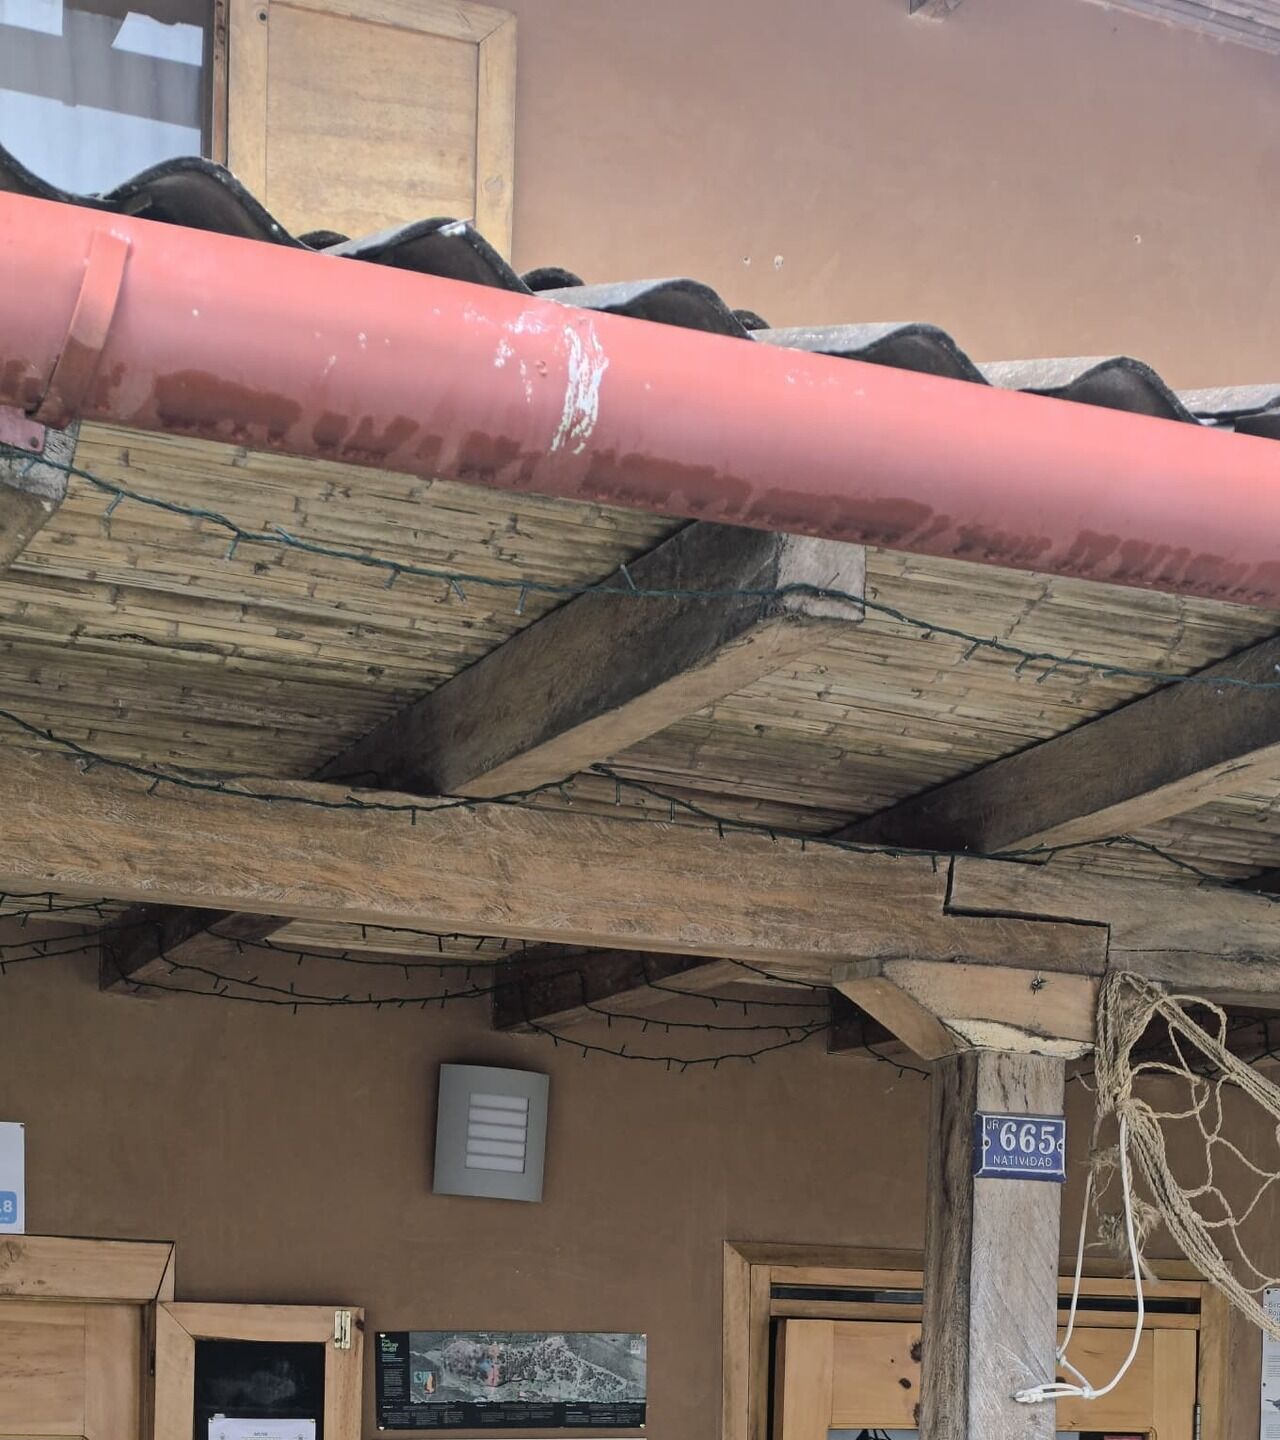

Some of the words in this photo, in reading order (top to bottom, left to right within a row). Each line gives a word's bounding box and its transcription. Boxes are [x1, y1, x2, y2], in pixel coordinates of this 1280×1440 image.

[986, 1119, 999, 1130] JR
[1000, 1121, 1056, 1155] 665
[993, 1155, 1053, 1167] NATIVIDAD
